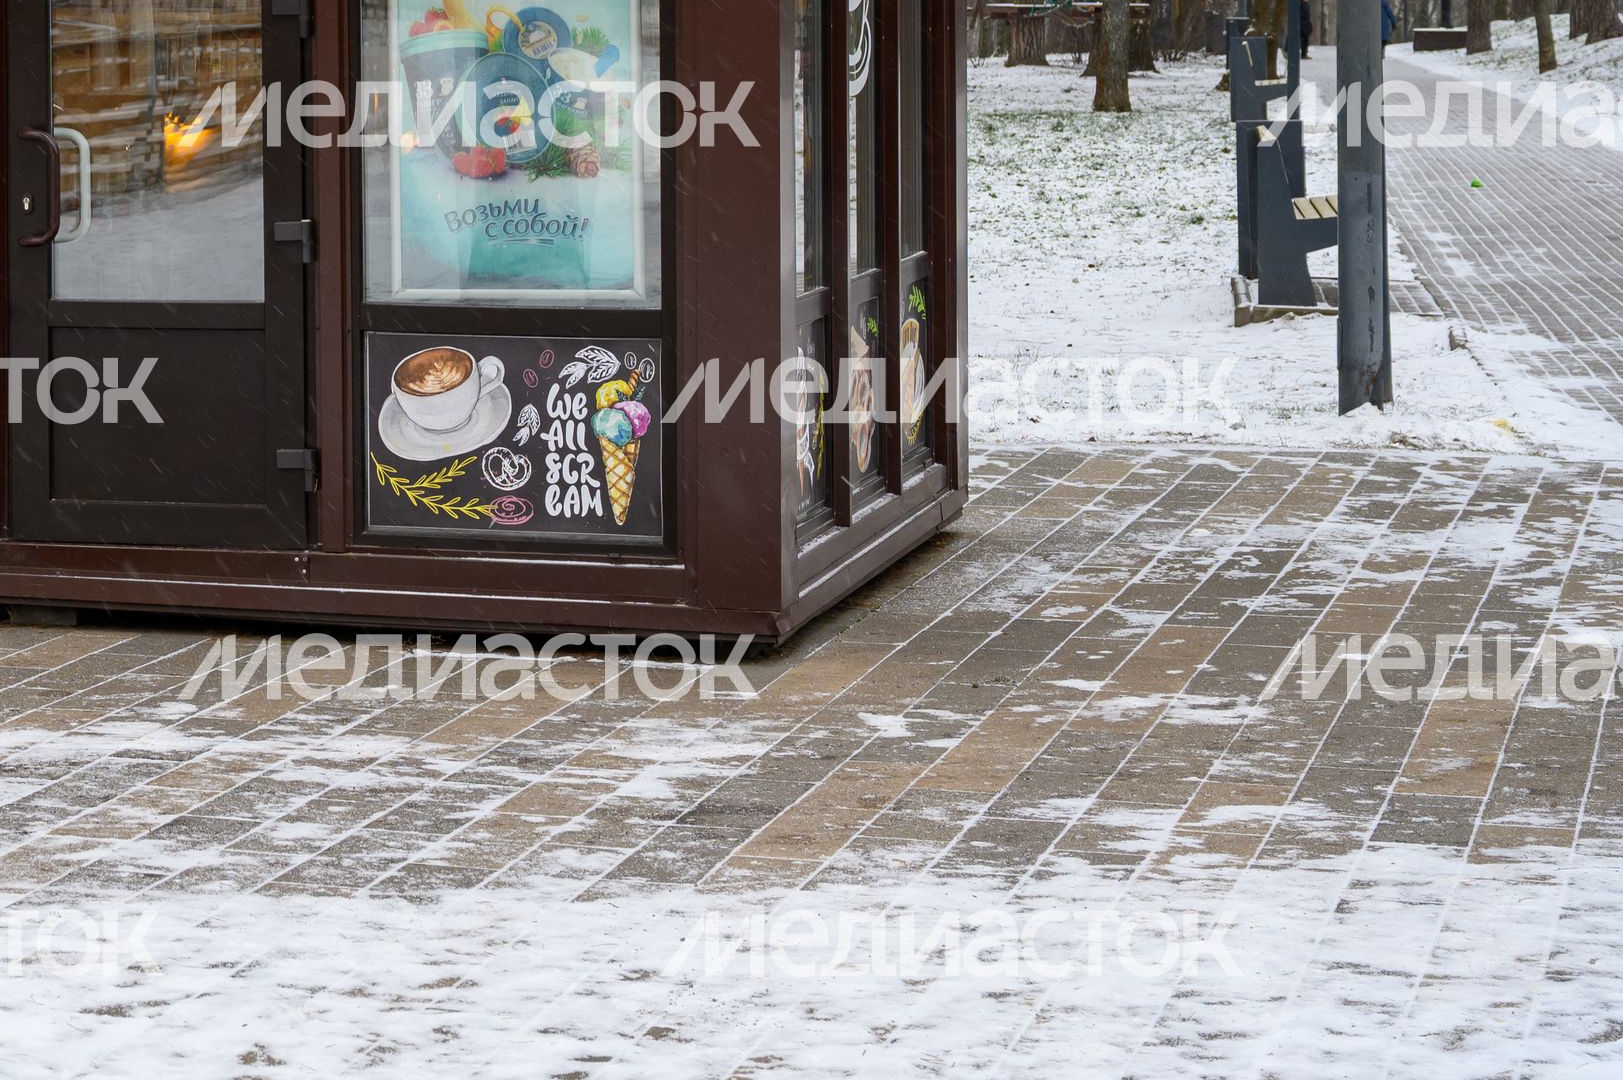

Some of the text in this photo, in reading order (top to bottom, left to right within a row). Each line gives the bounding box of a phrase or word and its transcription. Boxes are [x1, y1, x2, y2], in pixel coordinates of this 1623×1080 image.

[443, 198, 539, 233] Возьми
[485, 213, 589, 240] с собой!
